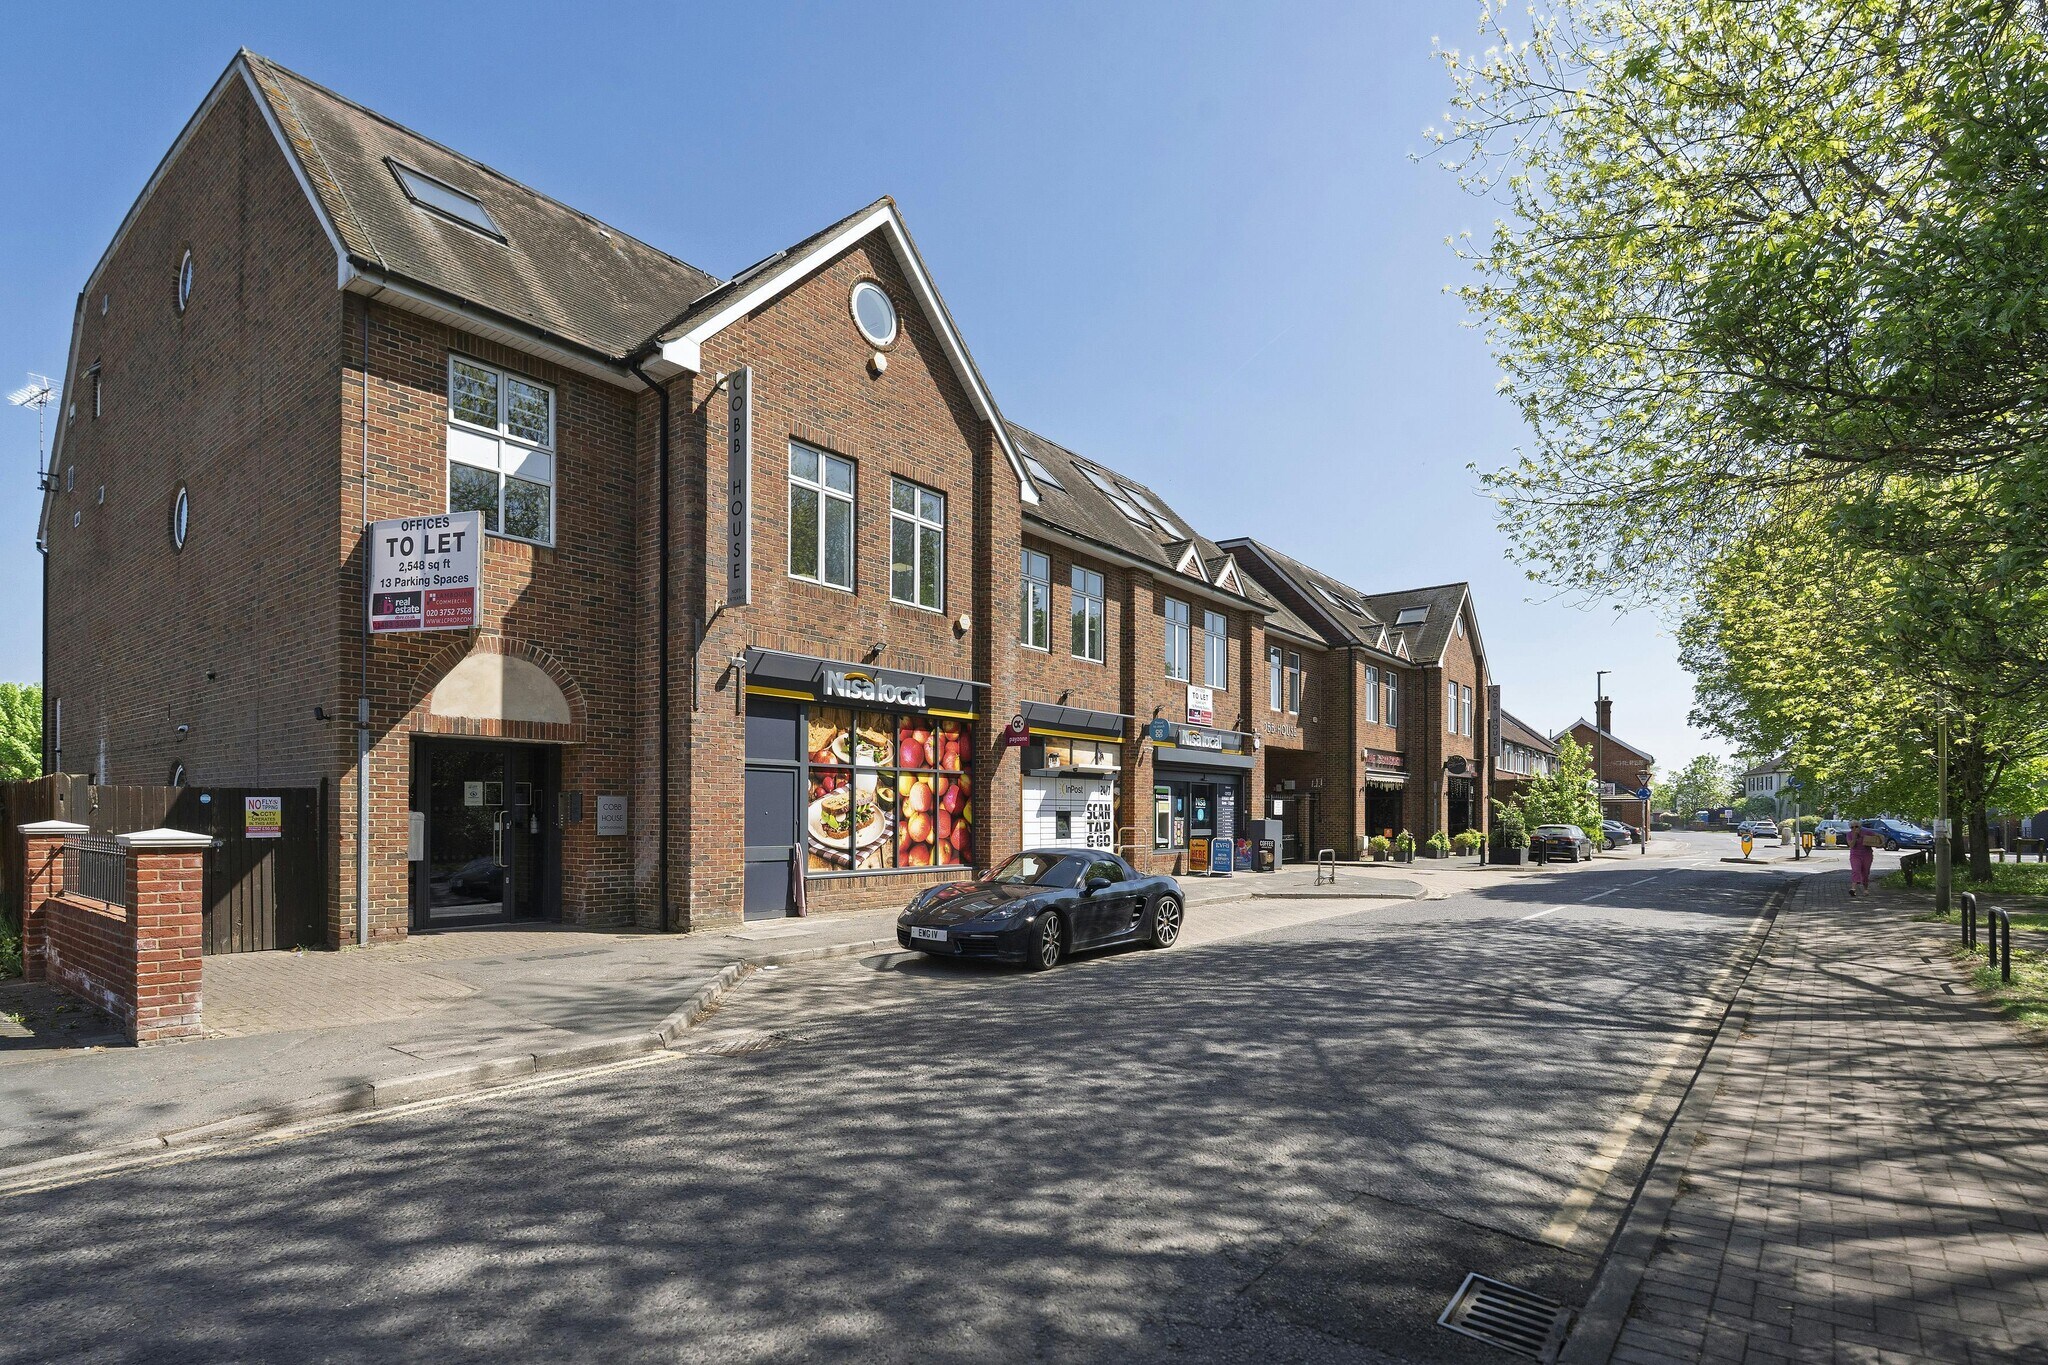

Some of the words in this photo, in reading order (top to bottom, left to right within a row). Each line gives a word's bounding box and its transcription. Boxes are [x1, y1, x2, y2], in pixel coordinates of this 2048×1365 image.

[731, 375, 743, 453] COBB
[401, 516, 450, 531] OFFICES
[731, 480, 743, 579] HOUSE
[386, 536, 414, 558] TO
[424, 531, 466, 554] LET
[398, 560, 425, 573] 2,548
[427, 561, 440, 572] sq
[442, 558, 451, 569] ft
[380, 578, 392, 588] 13
[394, 576, 431, 588] Parking
[433, 574, 469, 585] Spaces
[395, 597, 411, 606] real
[395, 605, 420, 614] estate
[426, 609, 438, 617] 020
[439, 608, 455, 616] 3752
[1066, 785, 1083, 794] InPost
[249, 800, 261, 809] NO
[1087, 803, 1111, 820] SCAN
[1087, 821, 1111, 835] TAP
